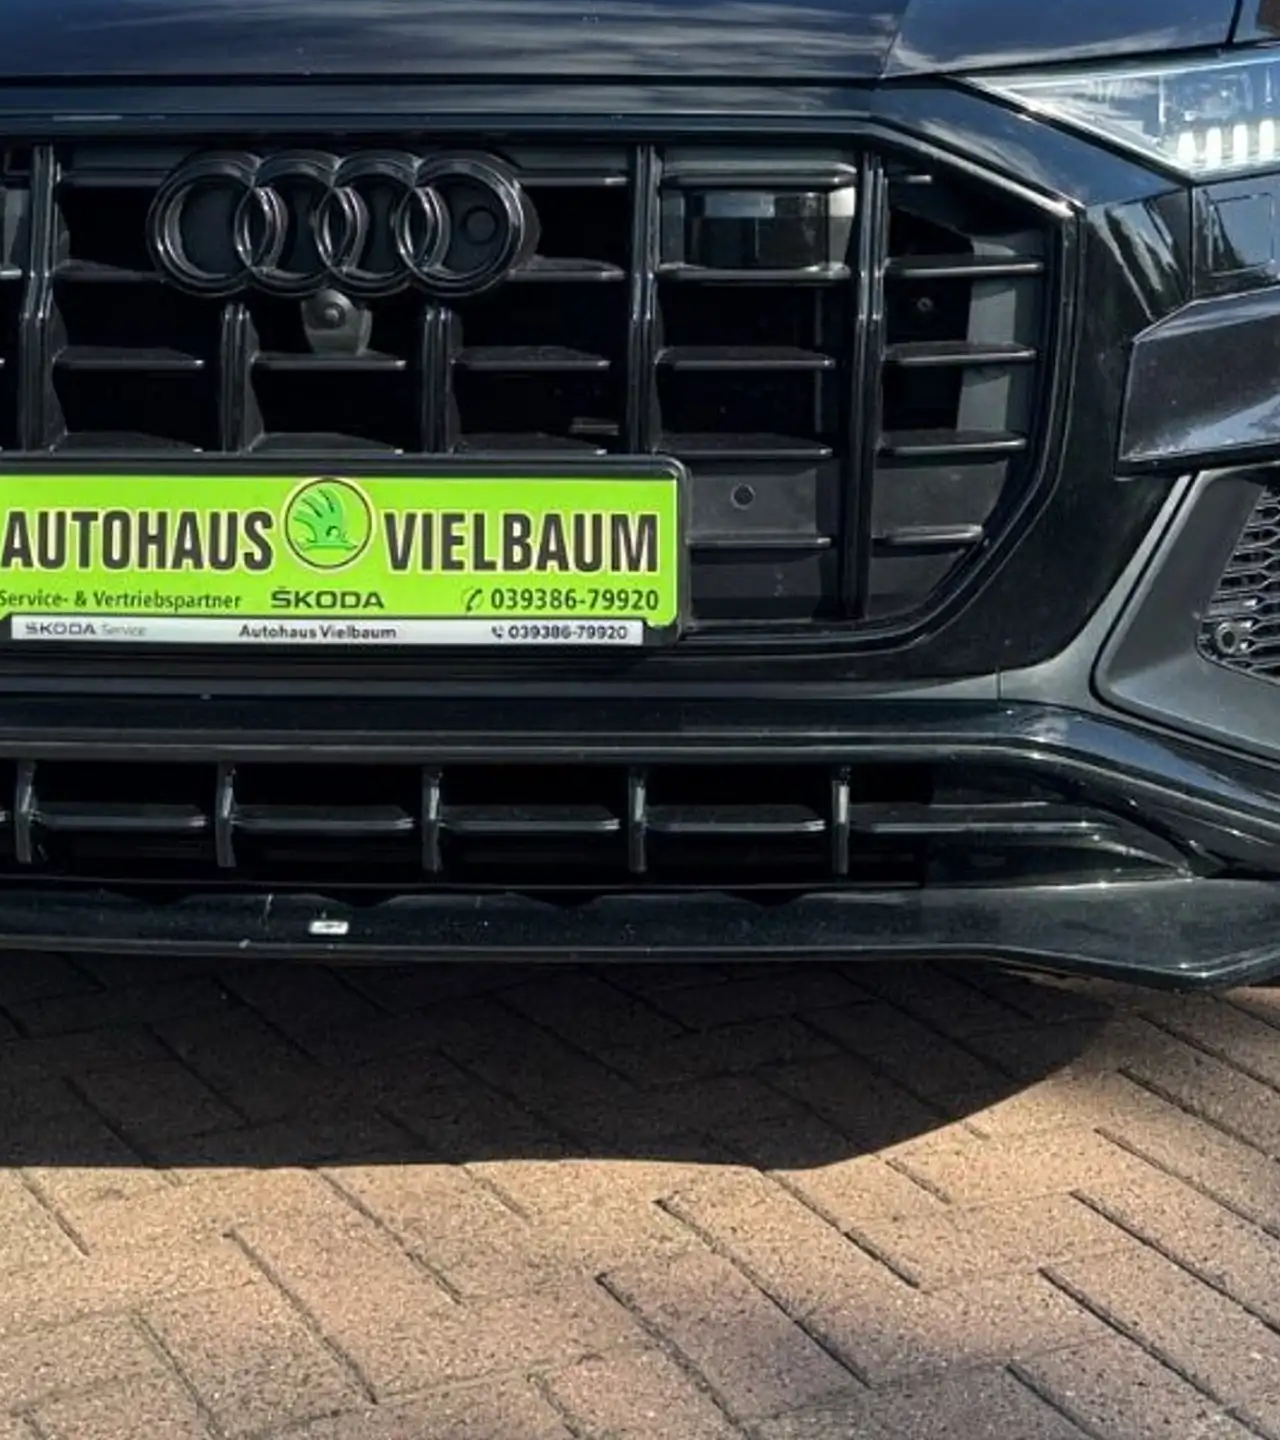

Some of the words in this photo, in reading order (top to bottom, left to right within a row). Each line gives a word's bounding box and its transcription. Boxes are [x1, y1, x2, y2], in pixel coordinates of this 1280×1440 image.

[0, 510, 274, 571] AUTOHAUS
[383, 512, 659, 572] VIELBAUM
[74, 590, 88, 606] &
[93, 590, 243, 612] Vertriebspartner
[271, 586, 385, 610] ŠKODA
[490, 589, 660, 612] 039386-79920
[239, 623, 318, 640] Autohaus
[319, 622, 397, 640] Vielbaum
[508, 625, 629, 640] 039386-79920
